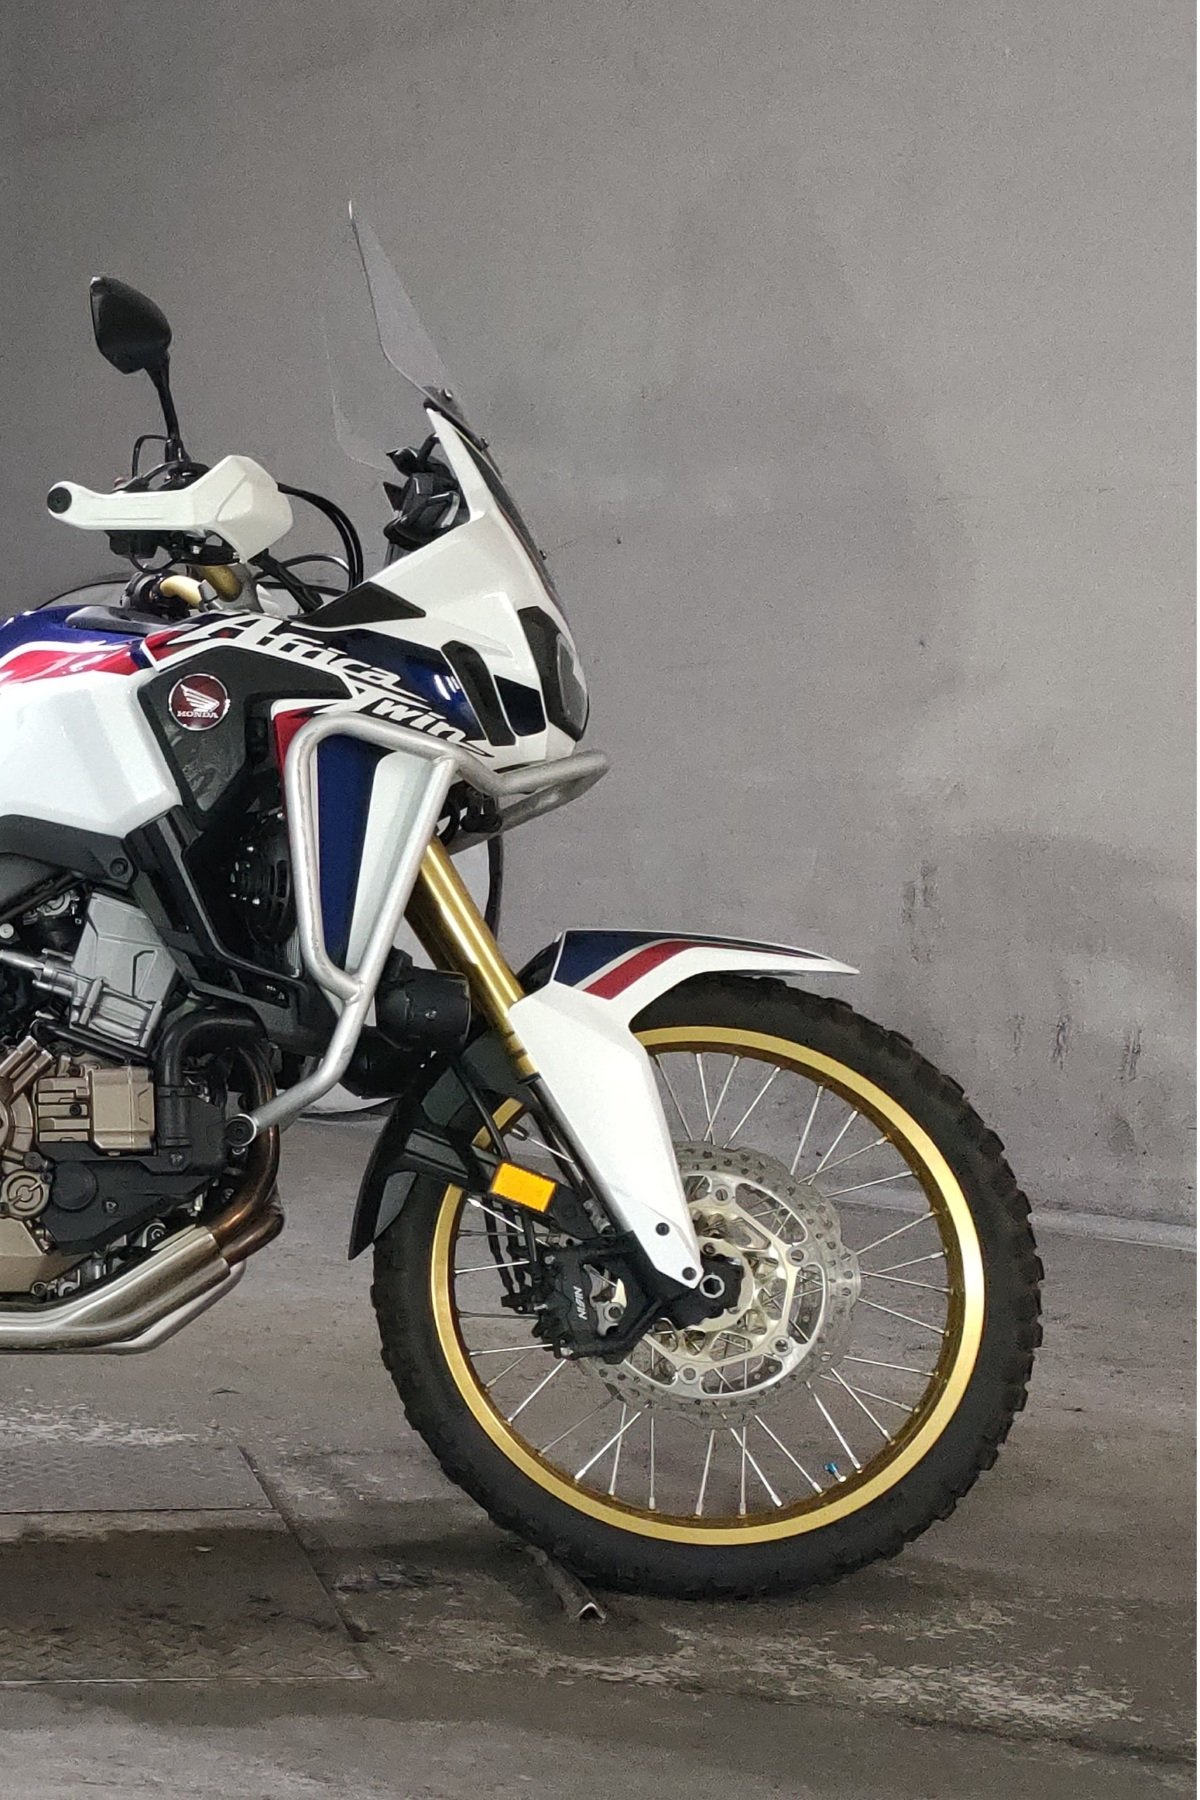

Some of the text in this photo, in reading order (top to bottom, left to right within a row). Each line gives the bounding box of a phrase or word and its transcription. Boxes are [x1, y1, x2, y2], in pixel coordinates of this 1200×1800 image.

[166, 614, 429, 702] Africa
[176, 710, 219, 719] HONDA
[313, 673, 492, 757] Twin
